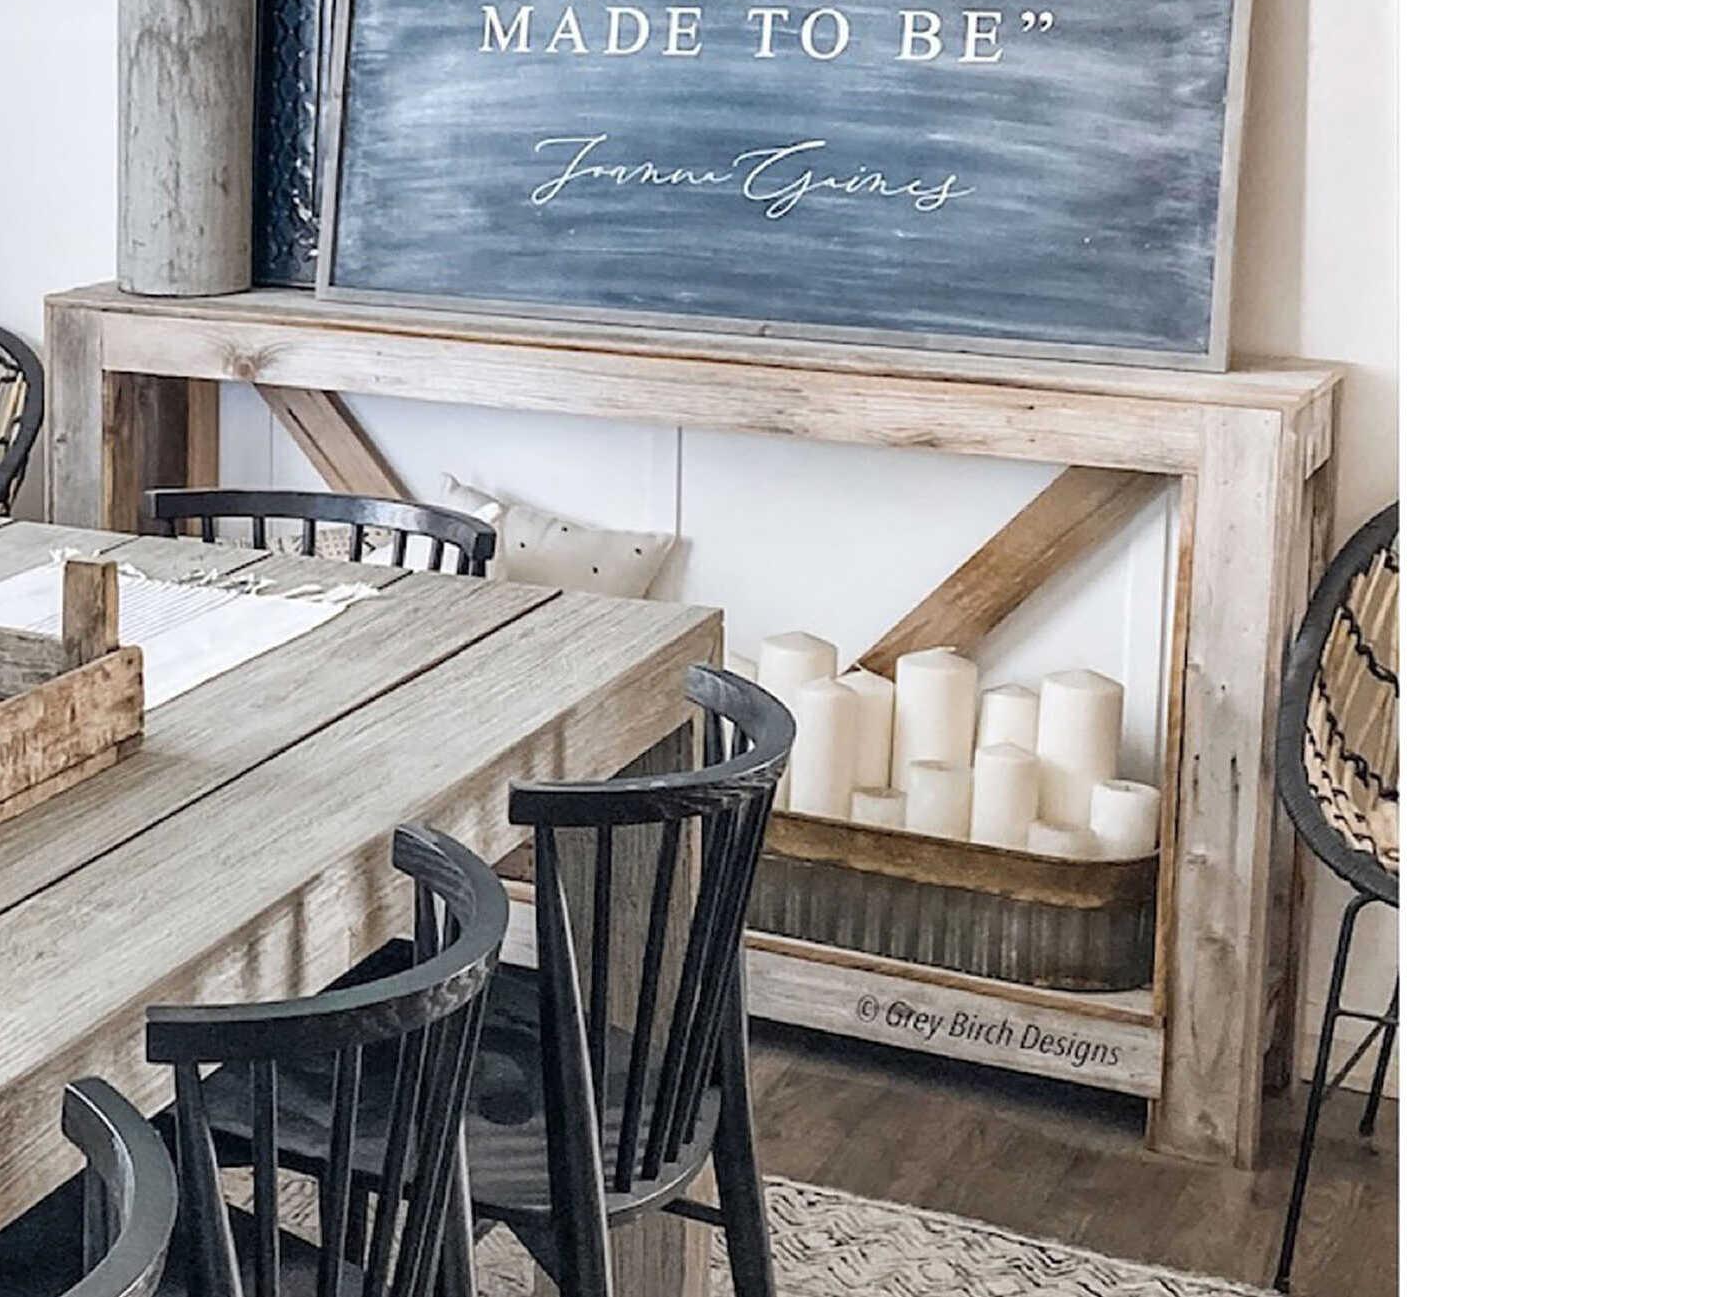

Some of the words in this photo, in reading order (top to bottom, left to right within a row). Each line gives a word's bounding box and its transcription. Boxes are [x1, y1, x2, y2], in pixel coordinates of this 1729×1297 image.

[479, 6, 702, 56] MADE
[748, 8, 851, 60] TO
[732, 139, 976, 219] Gaines
